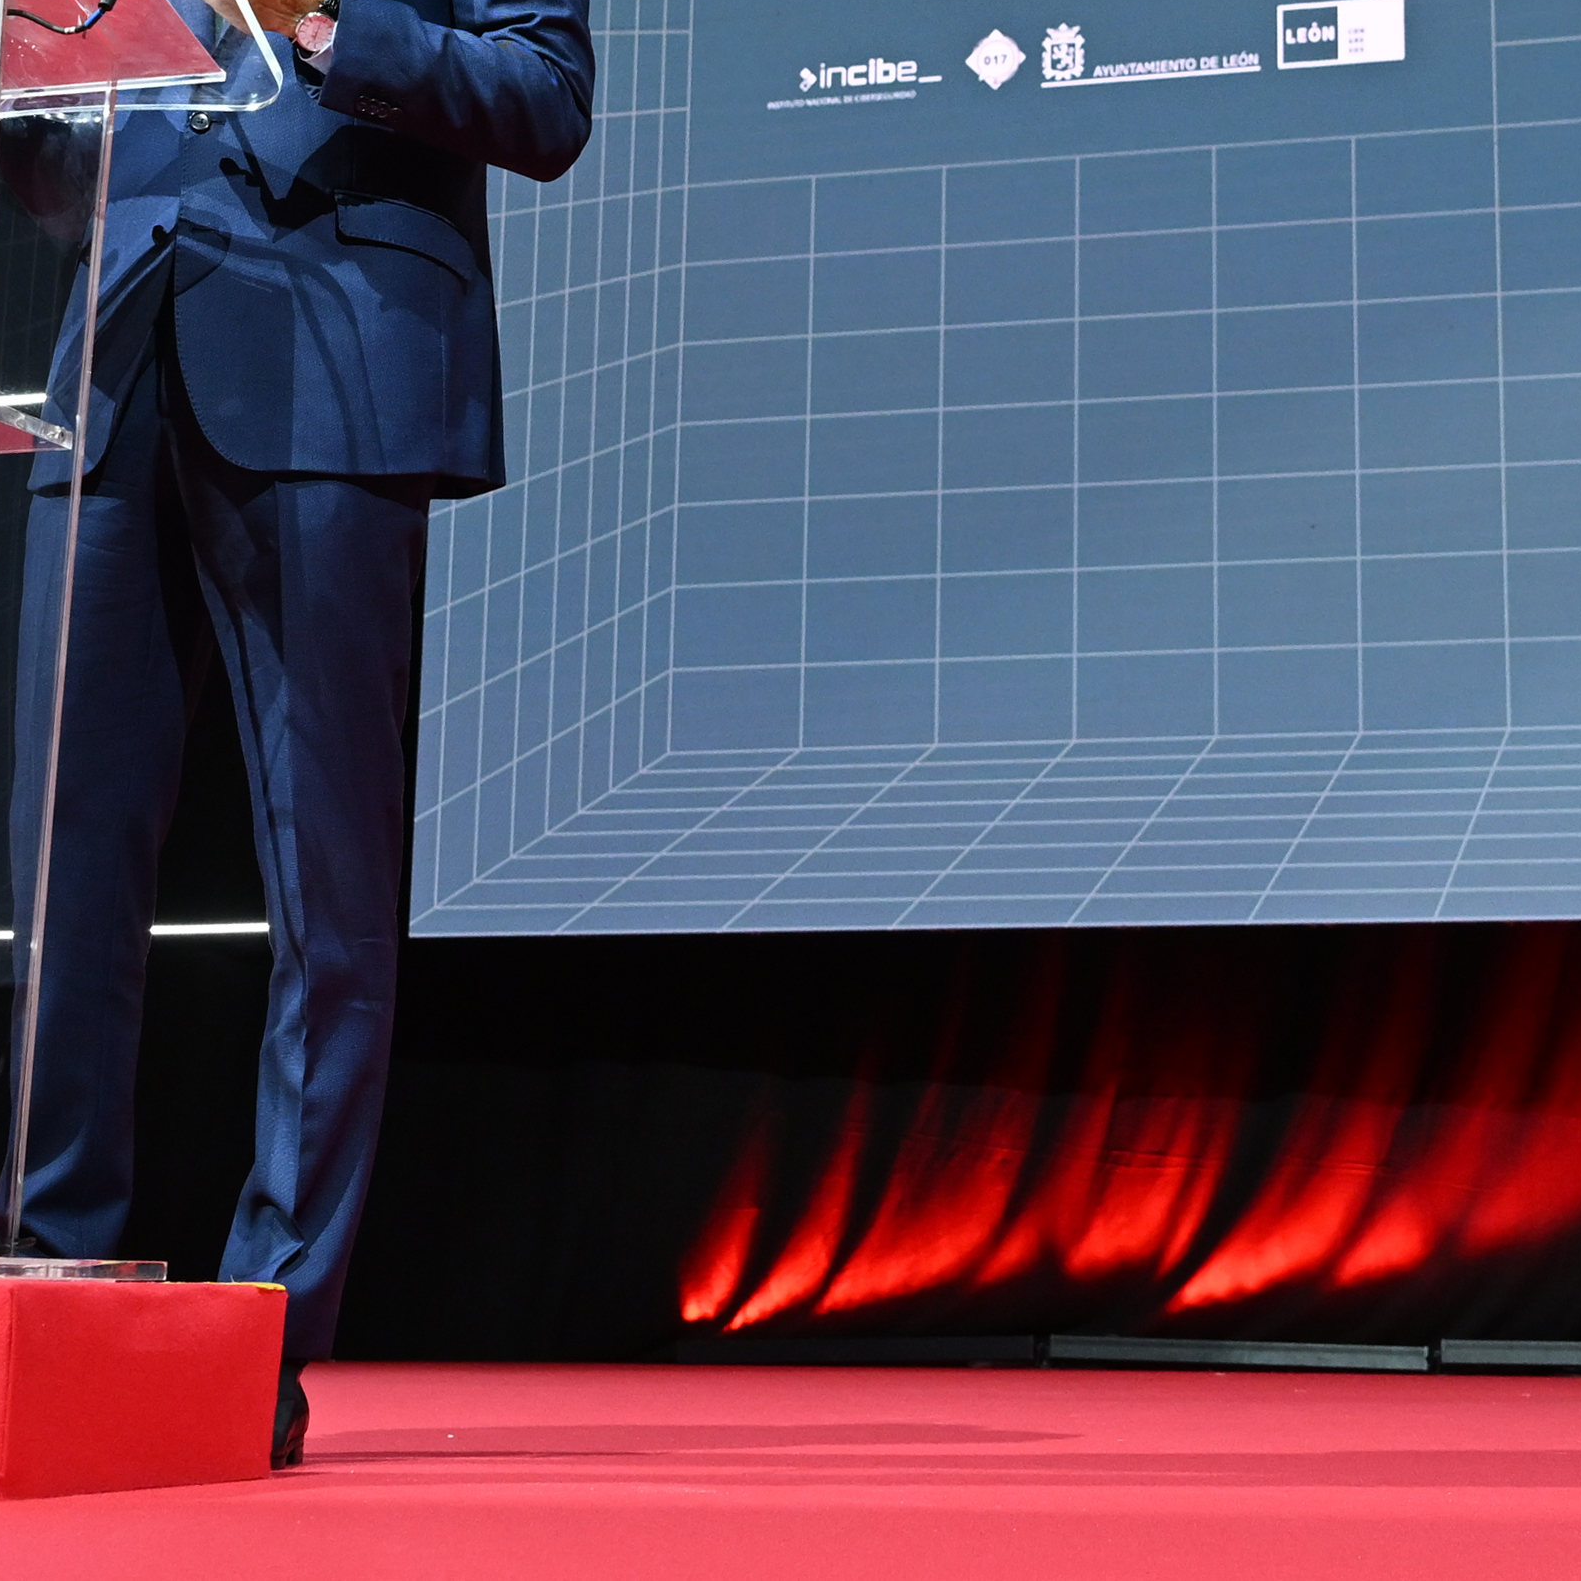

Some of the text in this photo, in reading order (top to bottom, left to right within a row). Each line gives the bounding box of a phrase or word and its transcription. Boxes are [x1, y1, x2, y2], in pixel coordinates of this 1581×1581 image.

[1285, 21, 1335, 45] LEÓN
[983, 54, 1008, 66] 017
[1093, 51, 1260, 78] AYUNTAMIENTO DE LEÓN
